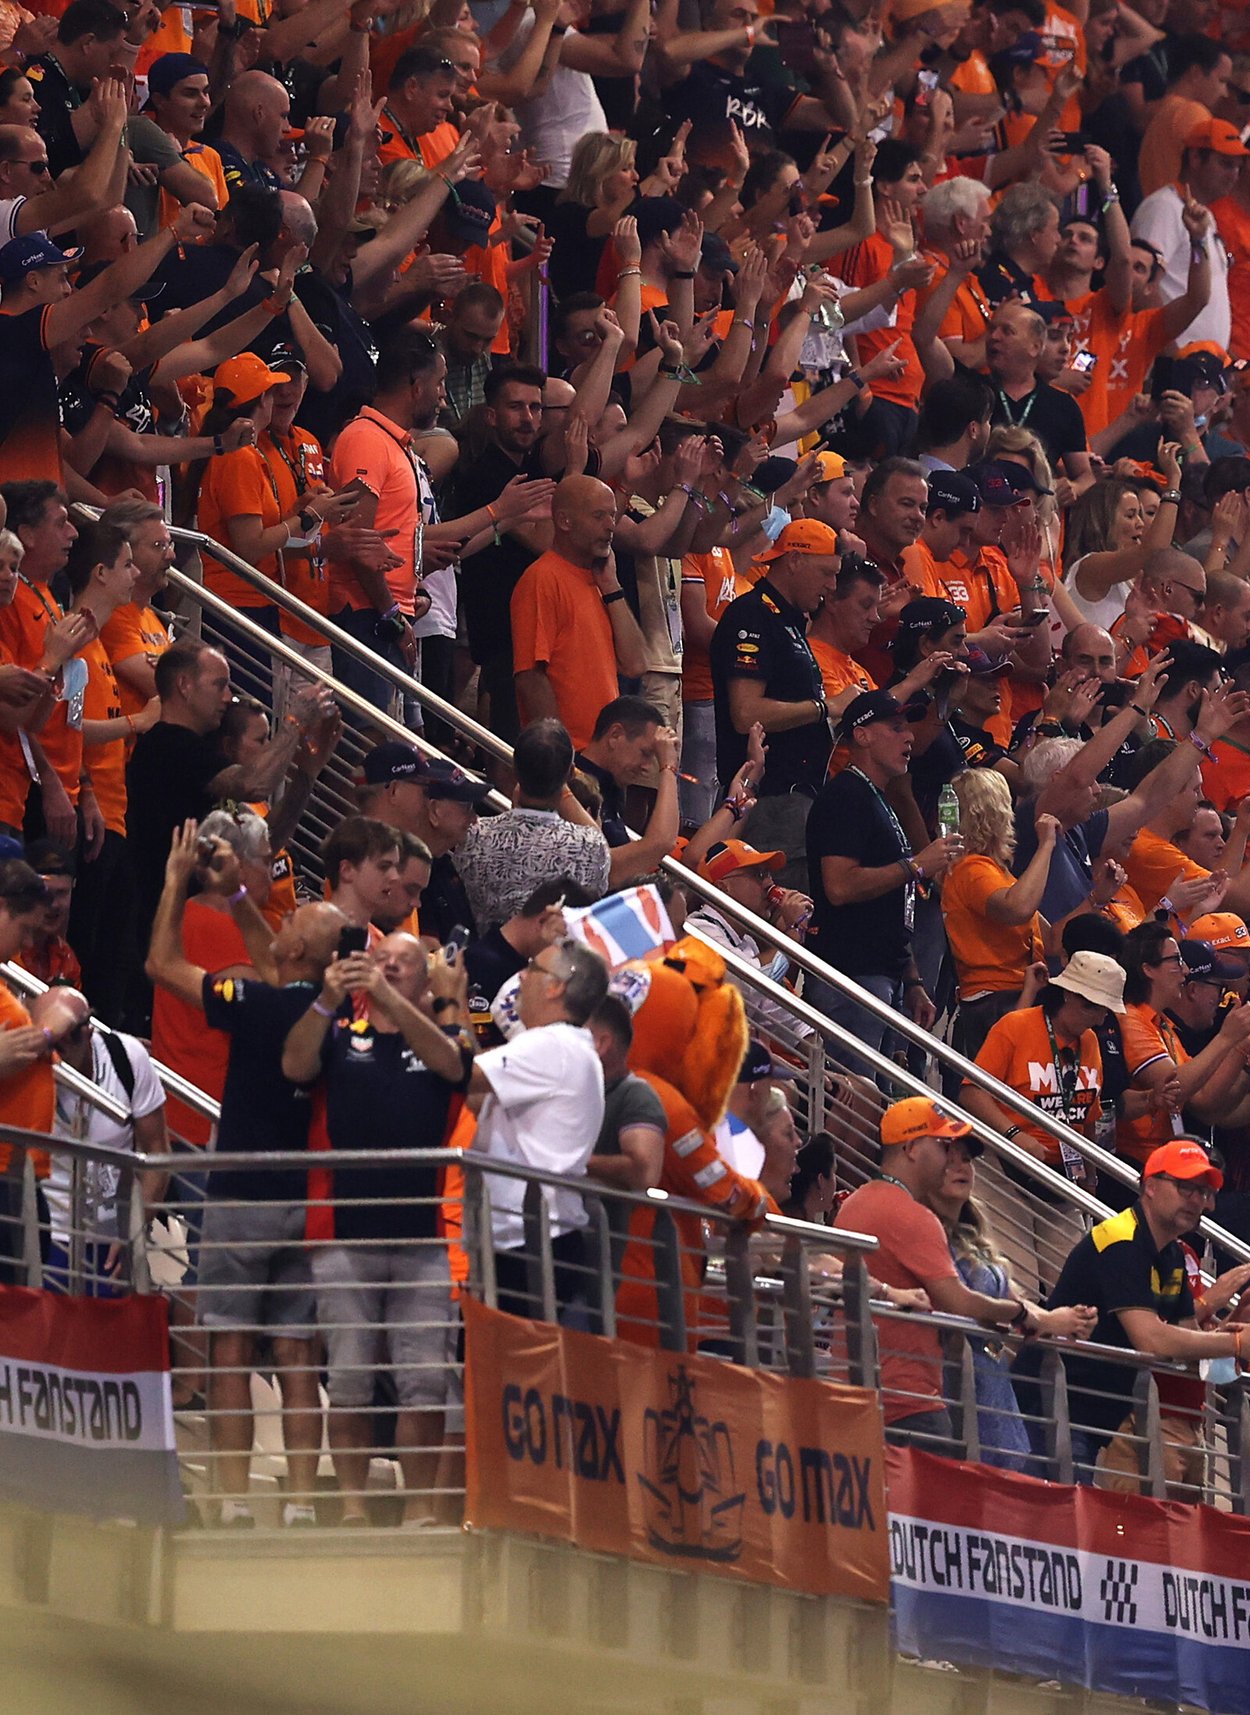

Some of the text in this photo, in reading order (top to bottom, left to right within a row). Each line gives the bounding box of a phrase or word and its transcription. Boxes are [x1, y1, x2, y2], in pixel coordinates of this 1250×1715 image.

[1041, 1096, 1064, 1109] WE
[503, 1384, 546, 1466] GO
[757, 1440, 796, 1519] GO
[892, 1520, 963, 1588] DUTCH
[1163, 1572, 1227, 1640] DUTCH
